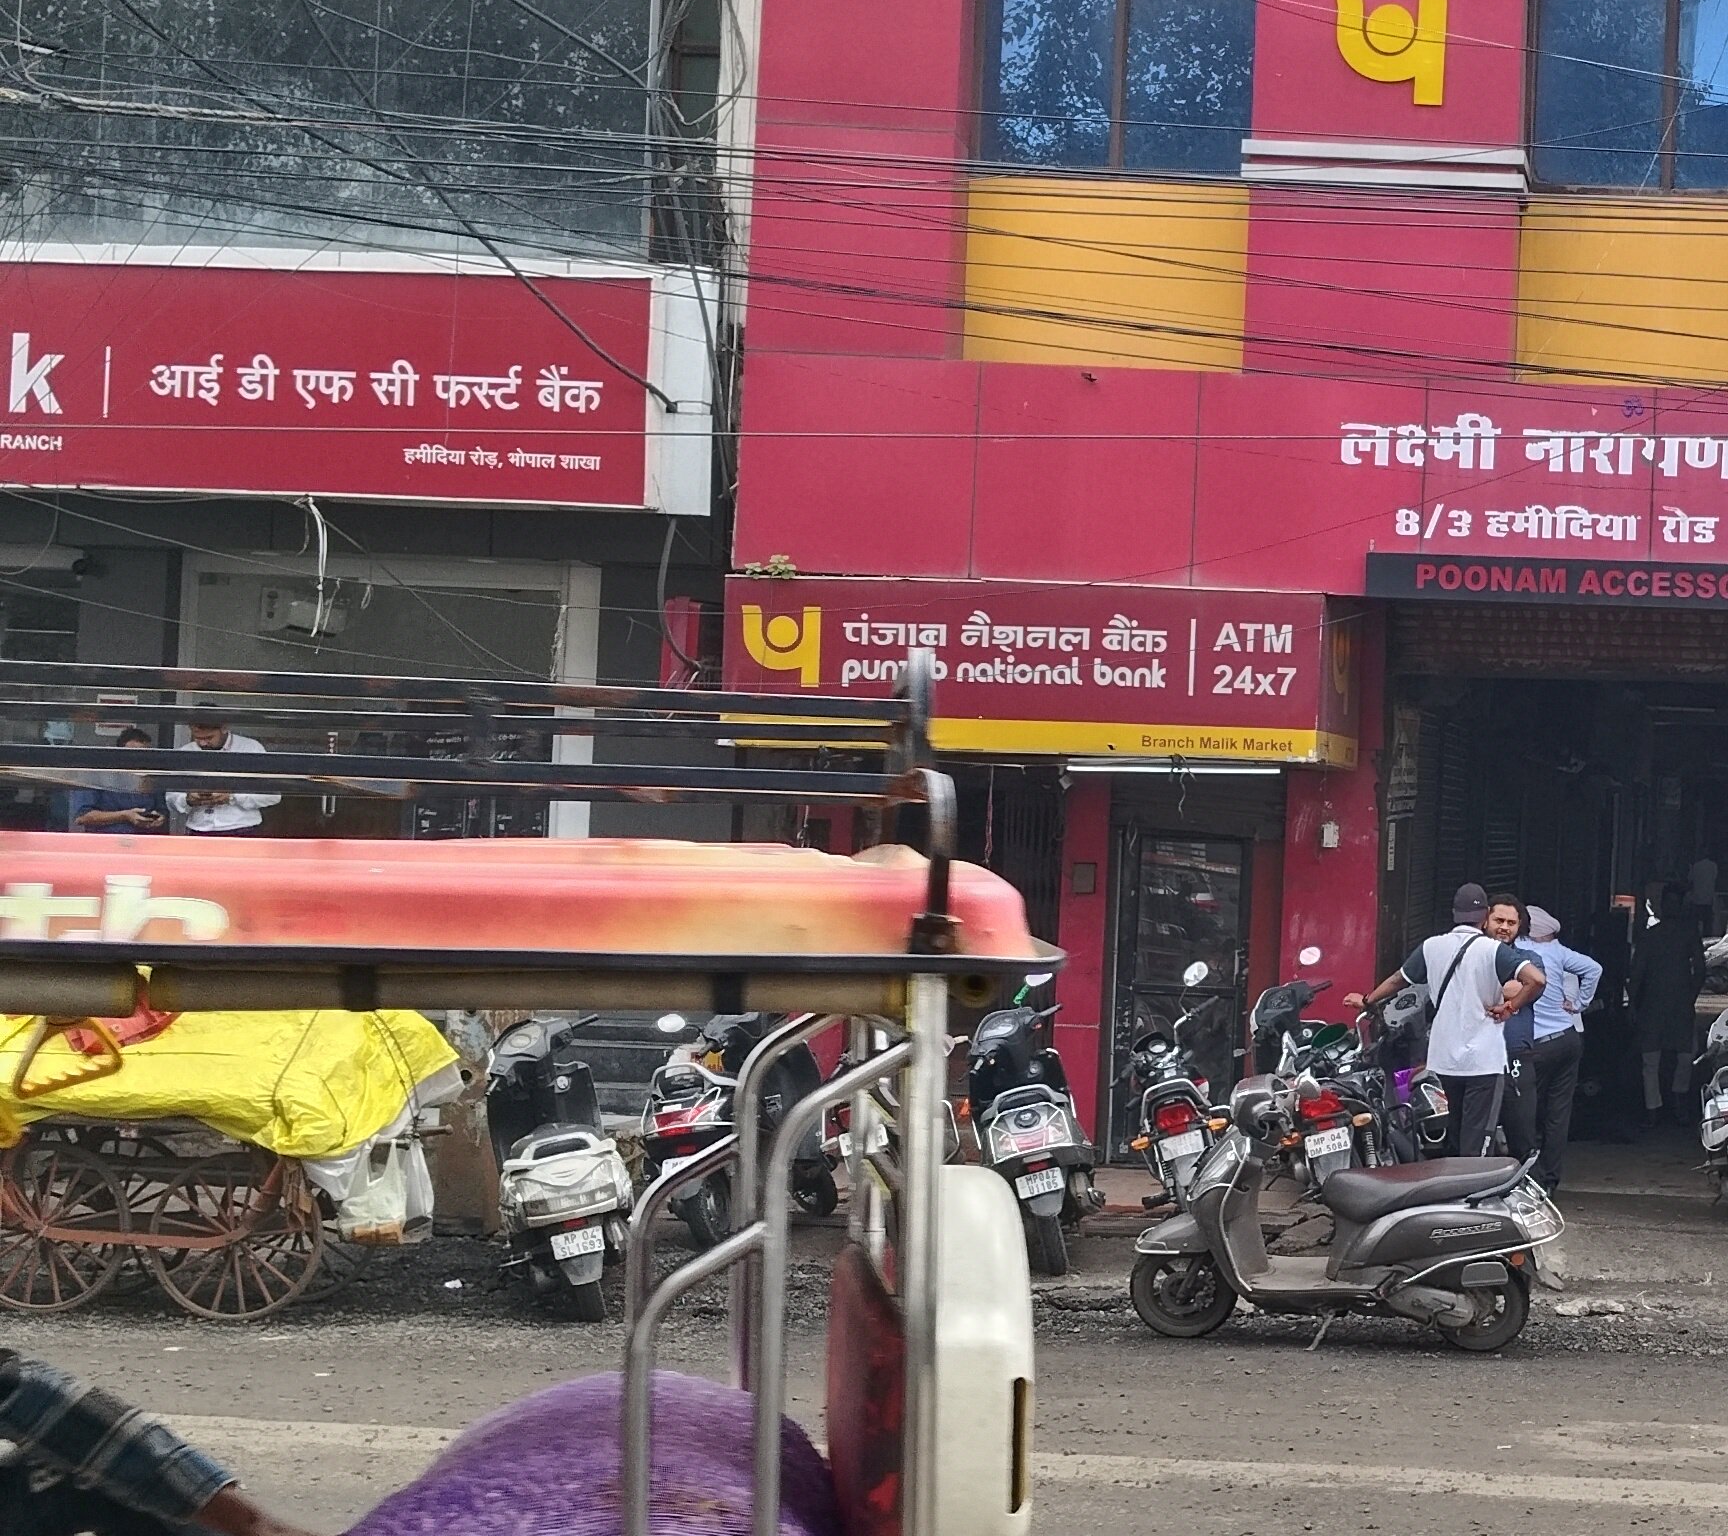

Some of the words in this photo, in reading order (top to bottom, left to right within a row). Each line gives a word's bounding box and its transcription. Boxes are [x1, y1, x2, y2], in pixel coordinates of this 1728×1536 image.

[8, 332, 64, 414] k
[149, 354, 223, 407] आई
[237, 354, 278, 403] डी
[294, 368, 356, 409] एफ
[370, 359, 419, 407] सी
[433, 365, 523, 412] फर्स्ट
[537, 365, 603, 414] बैंक
[403, 444, 466, 466] हमीदिया
[507, 448, 556, 468] भोपाल
[559, 454, 601, 470] शाखा
[1396, 503, 1471, 540] 8/3
[1485, 505, 1641, 541] हमीदिया
[1659, 506, 1719, 543] रोड
[1416, 564, 1567, 595] POONAM
[842, 612, 947, 647] पंजाब
[960, 609, 1091, 651] नैशनल
[1102, 613, 1168, 653] बैंक
[1213, 622, 1292, 654] ATM
[841, 653, 948, 687] punb
[957, 657, 1082, 687] national
[1094, 657, 1166, 689] bank
[1213, 666, 1296, 697] 24x7
[1141, 734, 1194, 750] Branch
[1199, 736, 1238, 751] Malik
[1243, 736, 1293, 753] Market
[1314, 1136, 1326, 1146] MP
[1331, 1132, 1342, 1142] 04
